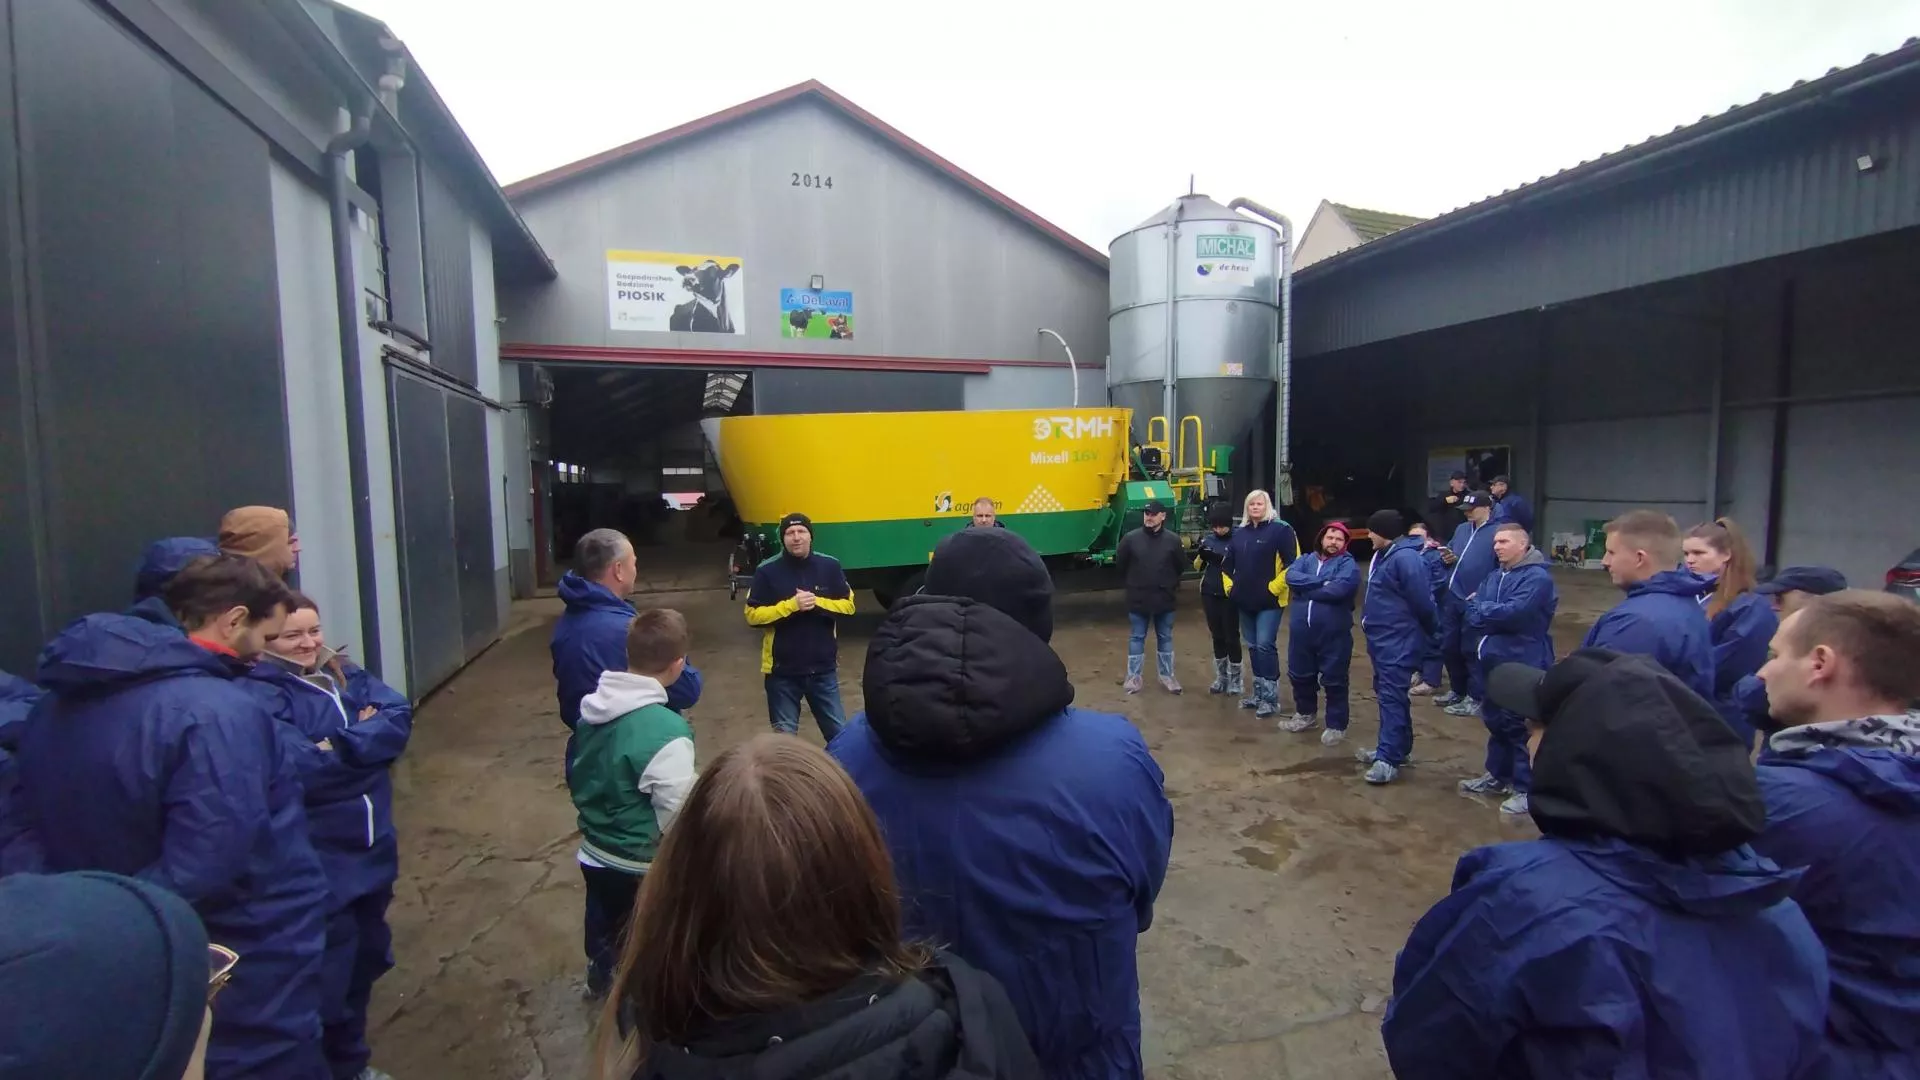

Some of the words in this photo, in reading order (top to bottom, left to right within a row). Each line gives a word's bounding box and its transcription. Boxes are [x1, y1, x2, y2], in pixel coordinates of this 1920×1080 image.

[791, 172, 833, 190] 2014
[618, 290, 666, 301] PIOSIK
[802, 294, 848, 307] DeLaval
[1030, 450, 1069, 464] Mixell
